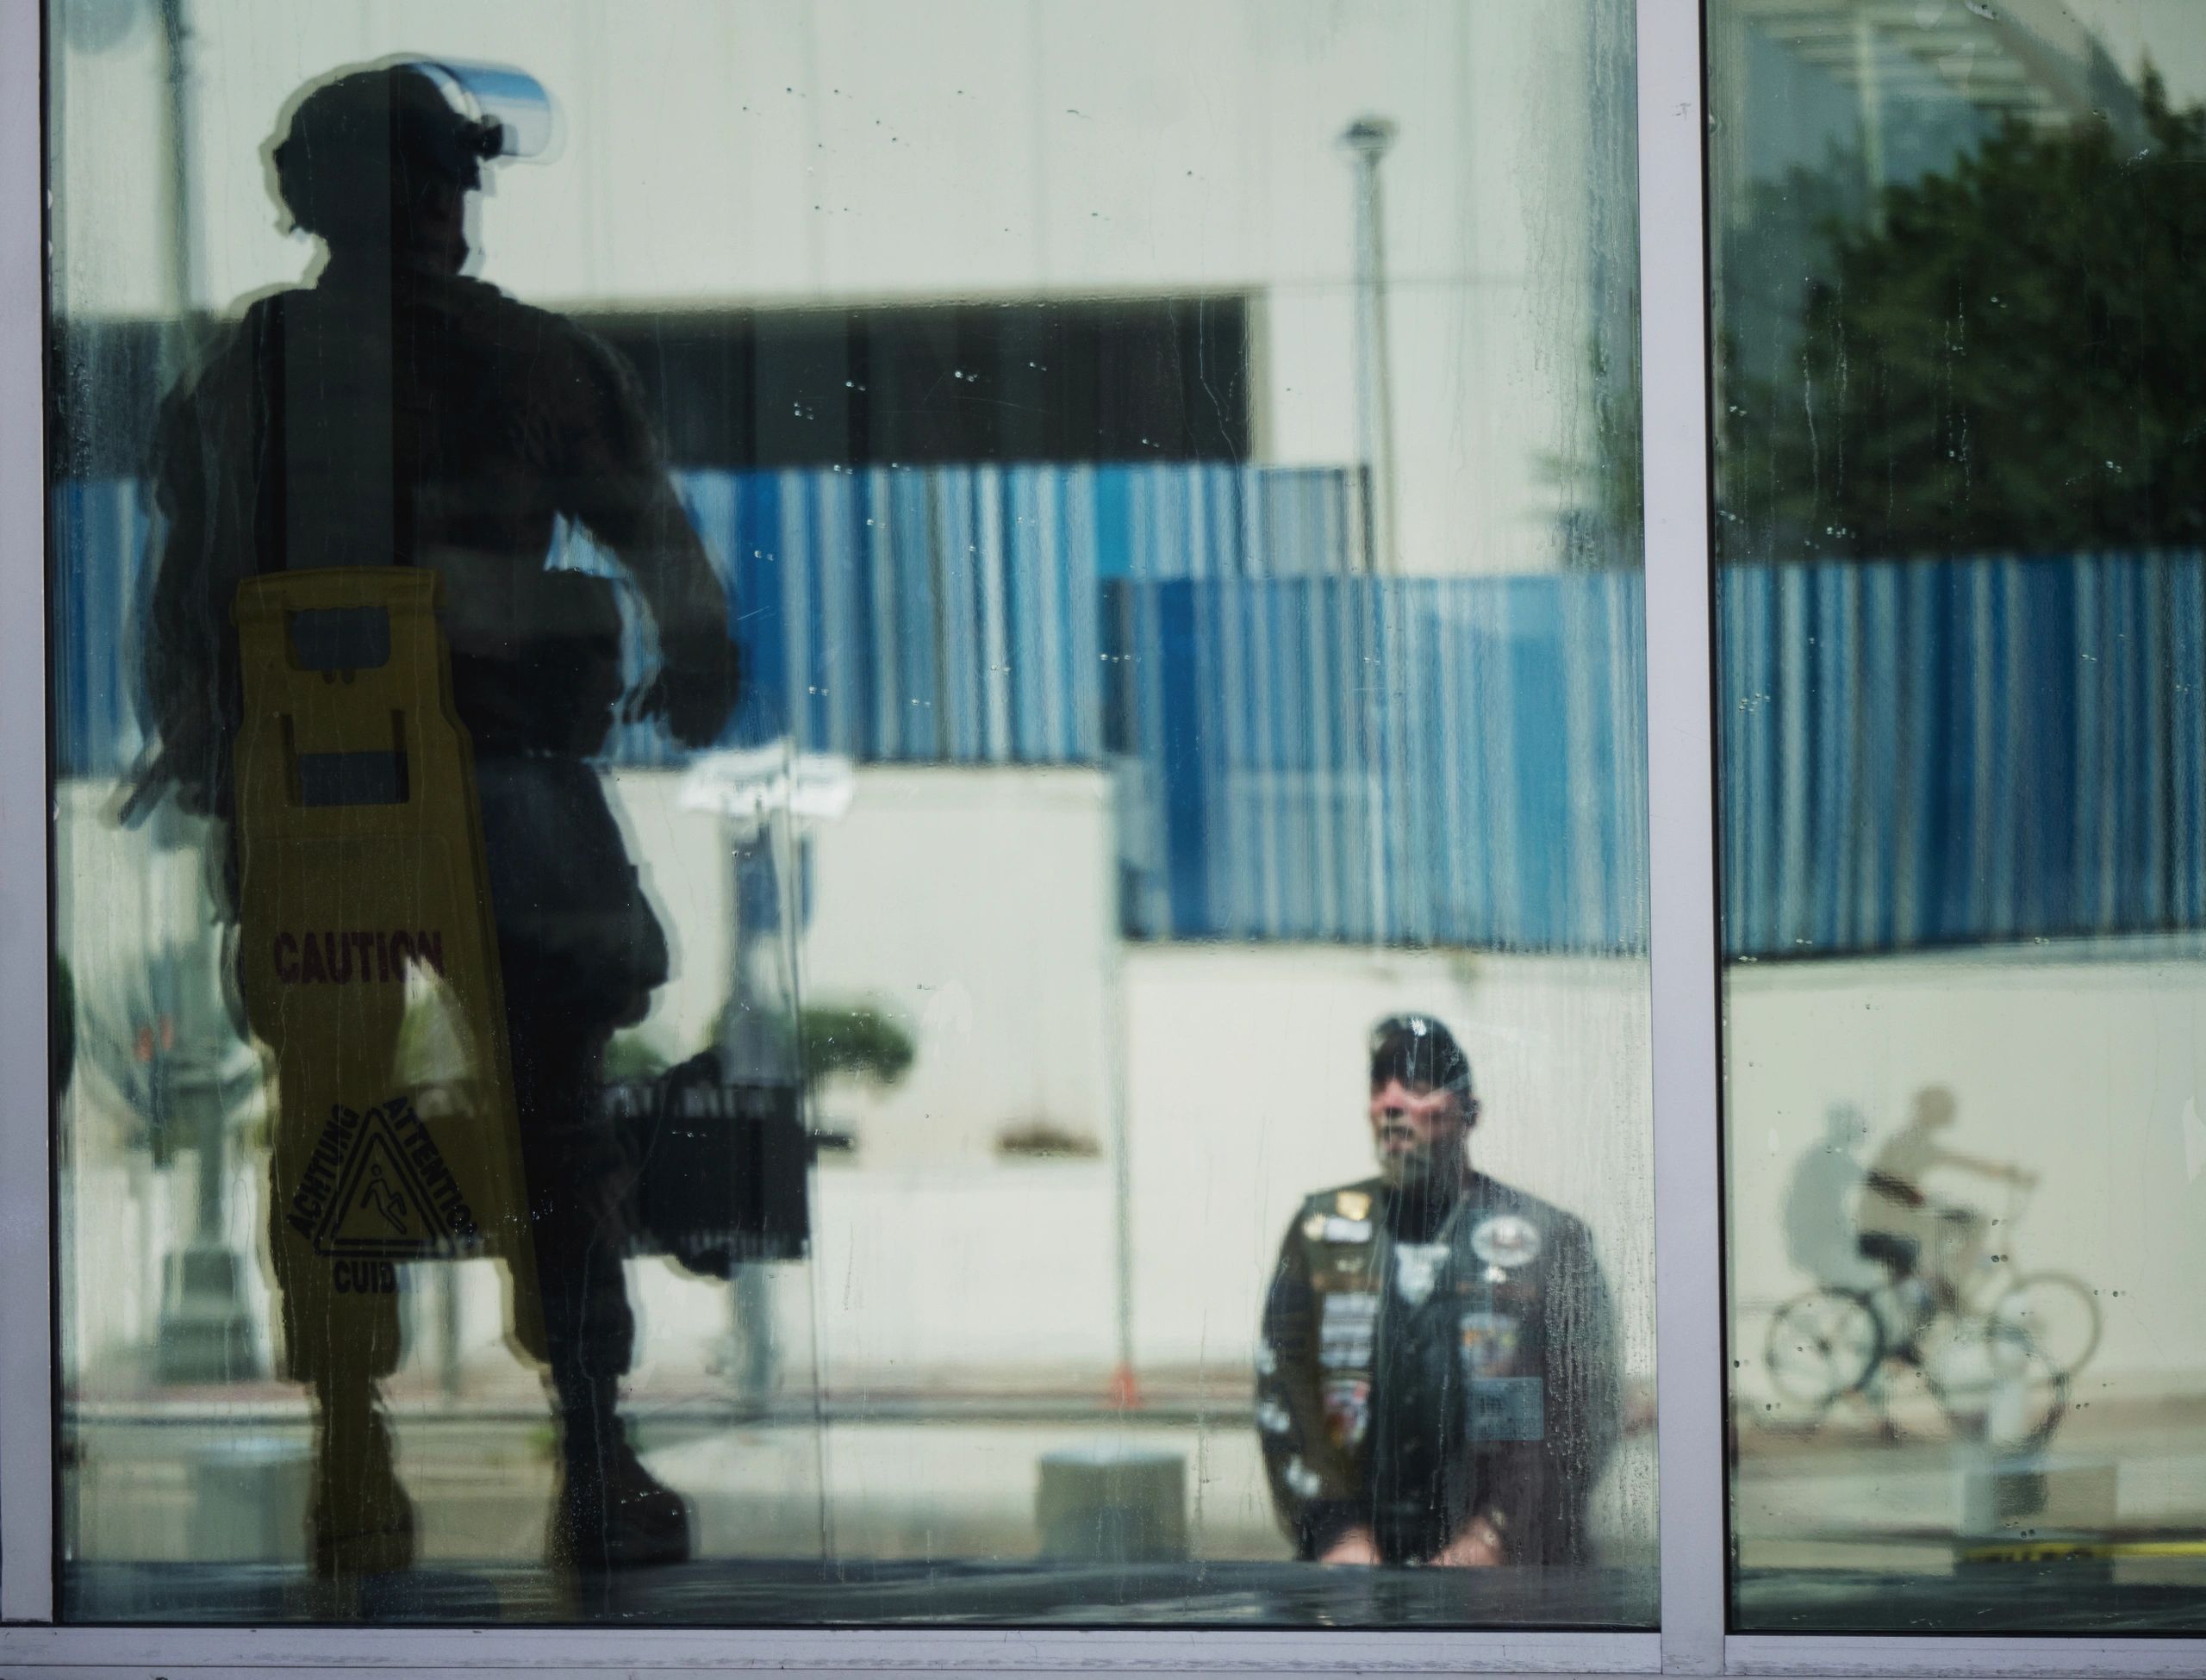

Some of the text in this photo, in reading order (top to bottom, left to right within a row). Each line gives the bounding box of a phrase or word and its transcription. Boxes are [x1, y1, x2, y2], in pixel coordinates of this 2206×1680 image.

[274, 930, 445, 984] CAUTION
[286, 1103, 359, 1240] ACHTUNG
[333, 1260, 397, 1294] CUID
